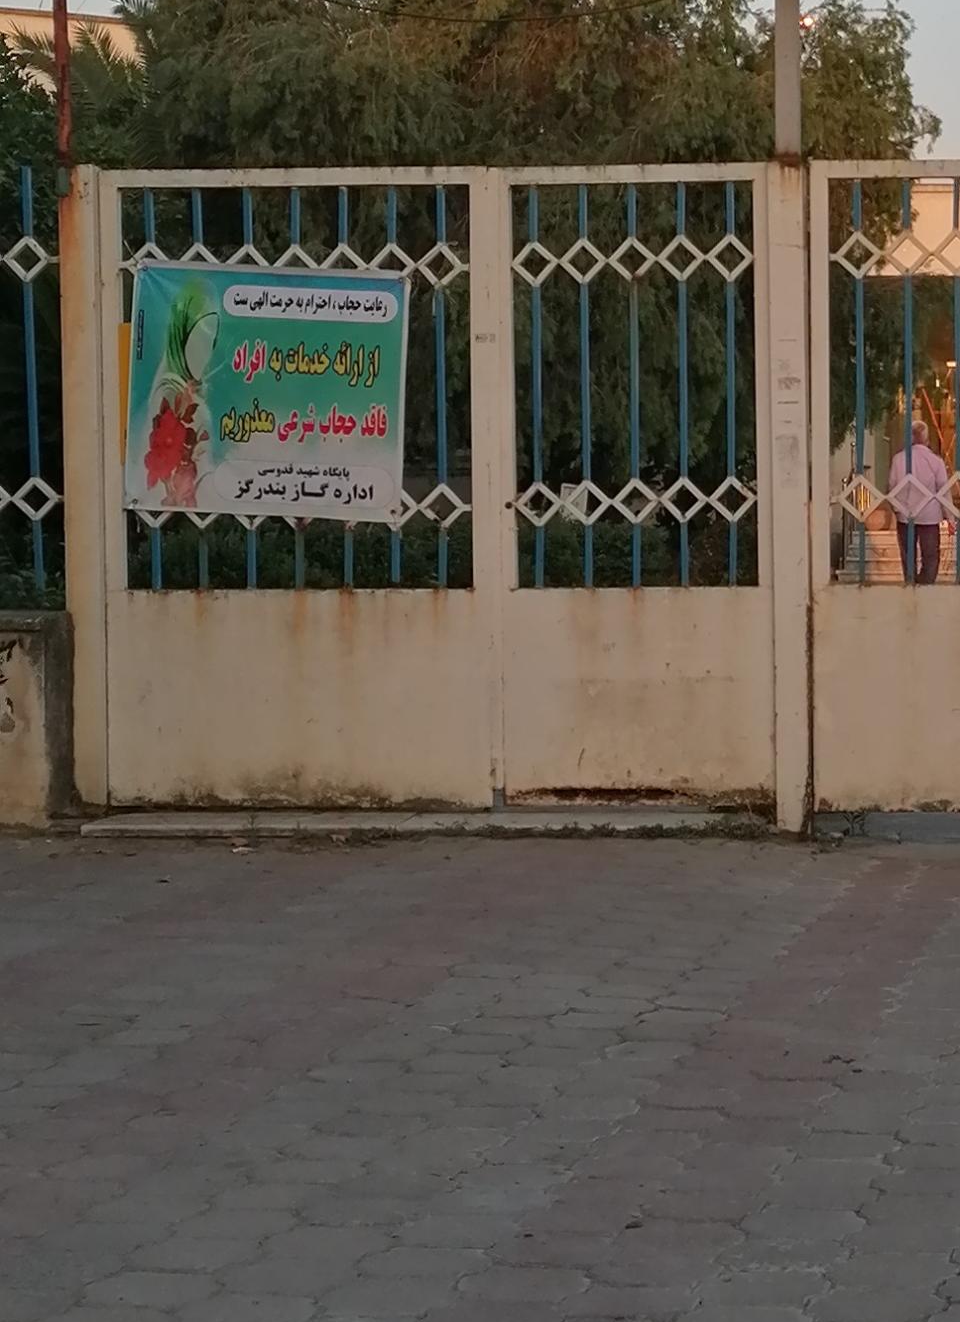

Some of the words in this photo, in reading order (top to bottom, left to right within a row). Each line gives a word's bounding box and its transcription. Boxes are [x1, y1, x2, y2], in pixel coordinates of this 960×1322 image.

[363, 296, 388, 317] رعایت
[232, 338, 267, 384] افراد
[268, 347, 284, 382] به
[283, 341, 331, 375] خدمات
[363, 344, 381, 387] از
[219, 397, 276, 443] معذوریم
[276, 404, 316, 443] شرعی
[318, 402, 357, 444] حجاب
[360, 403, 388, 438] فاقد
[257, 463, 294, 478] قدوسی
[296, 465, 320, 478] شهید
[333, 483, 374, 505] اداره
